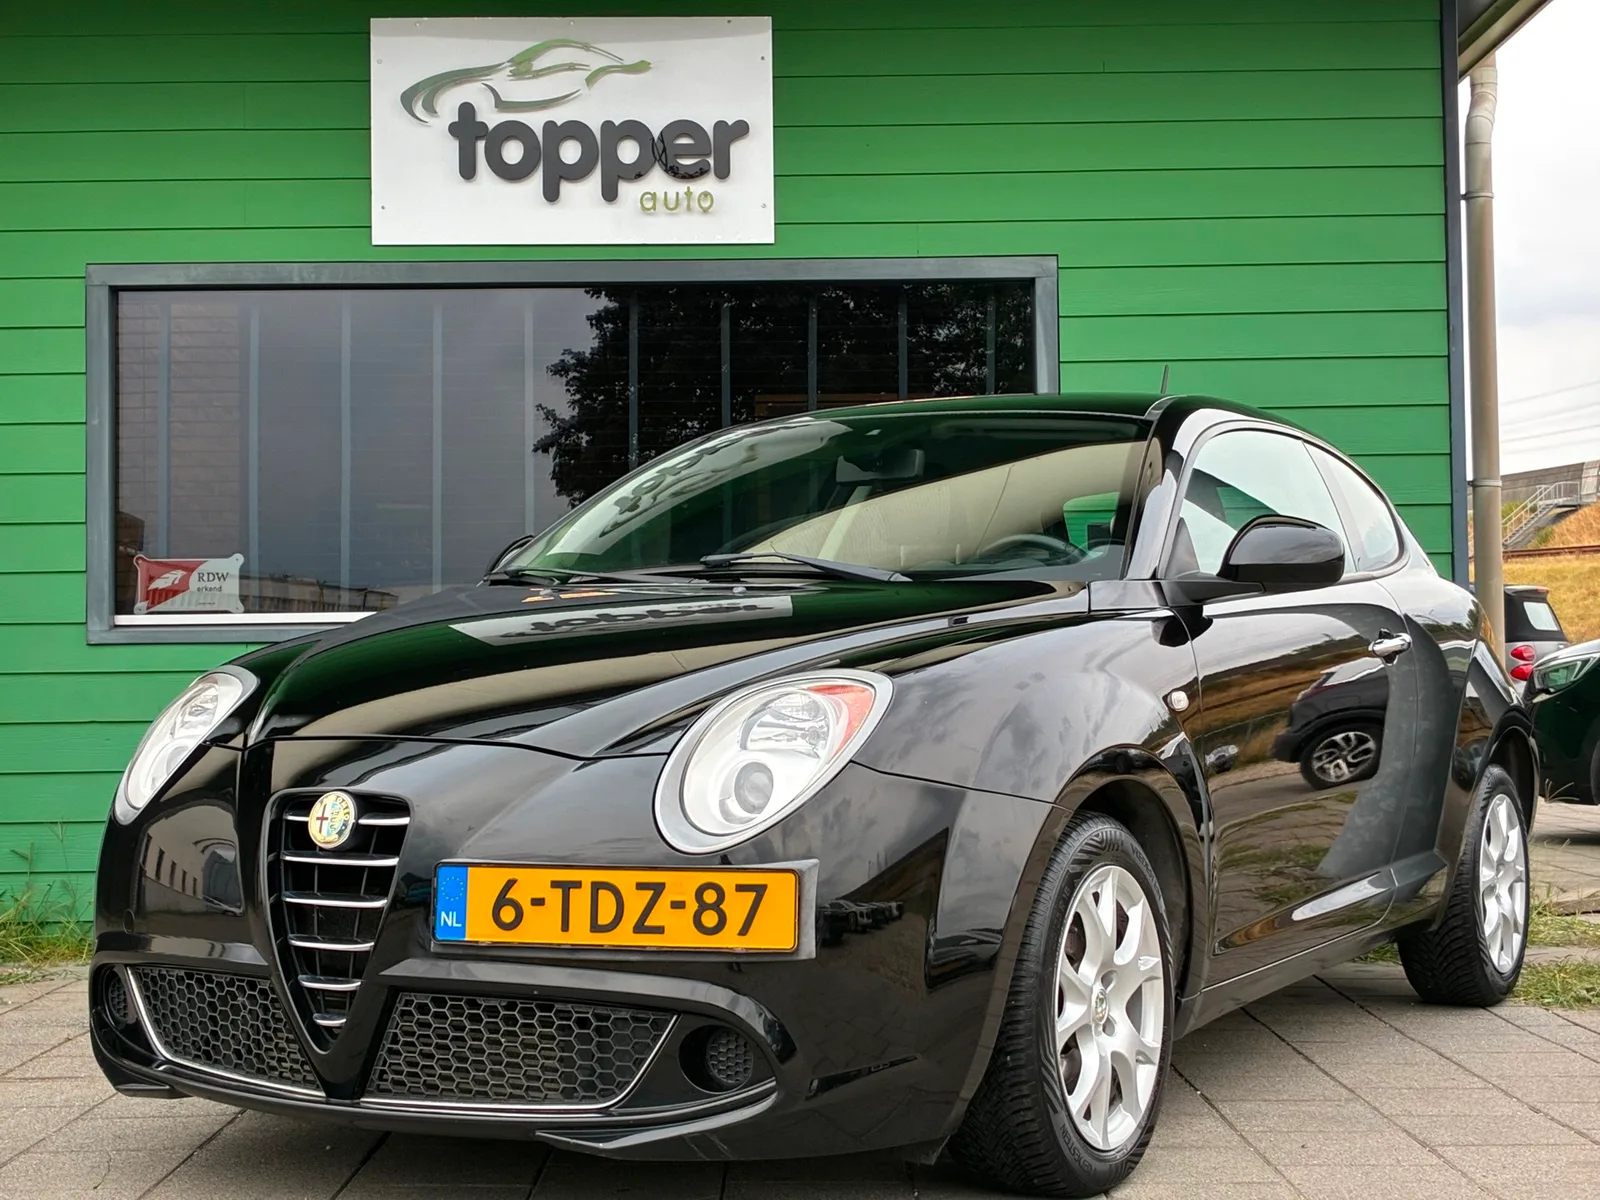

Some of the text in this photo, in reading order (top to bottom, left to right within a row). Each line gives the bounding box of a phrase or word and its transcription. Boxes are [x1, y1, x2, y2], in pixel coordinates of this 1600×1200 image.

[448, 101, 750, 203] topper
[640, 186, 715, 213] auto
[198, 572, 229, 582] RDW
[440, 911, 462, 928] NL
[491, 878, 768, 936] 6-TDZ-87
